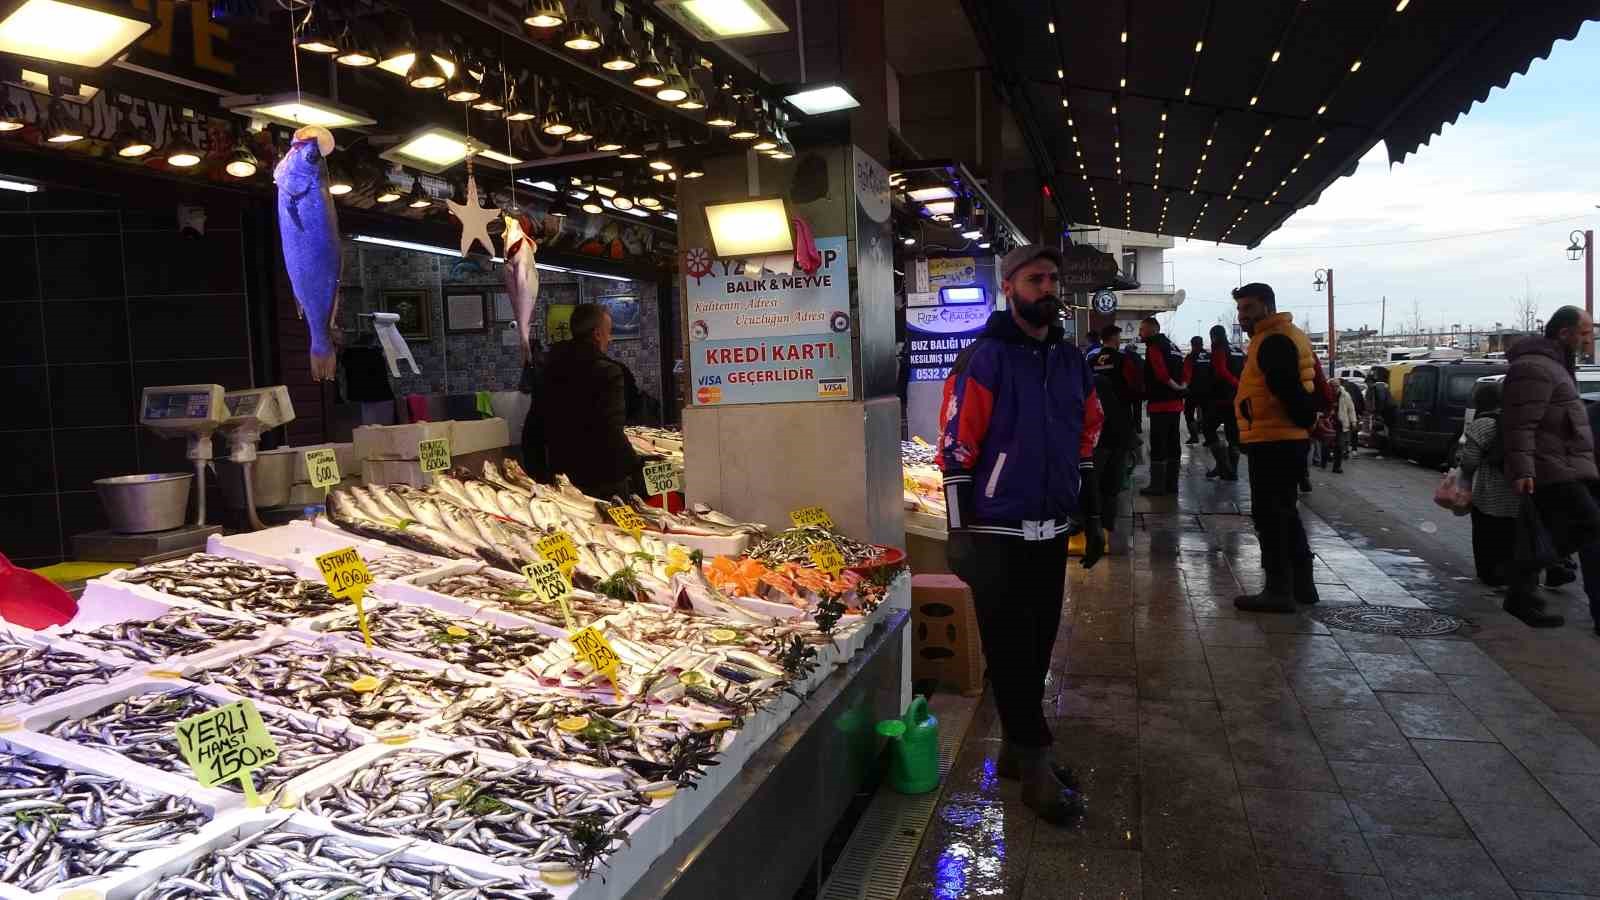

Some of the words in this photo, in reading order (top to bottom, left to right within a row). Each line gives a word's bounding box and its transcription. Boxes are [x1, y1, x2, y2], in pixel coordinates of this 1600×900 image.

[726, 280, 766, 293] BALIK
[770, 279, 780, 290] &
[782, 275, 832, 289] MEYVE
[695, 302, 738, 312] Kalitenin
[745, 297, 778, 311] Adresi
[735, 312, 790, 327] Ucuzluğun
[793, 311, 825, 322] Adresi
[911, 340, 929, 350] BUZ
[930, 337, 958, 350] BALIĞI
[960, 338, 976, 349] VA
[706, 342, 766, 365] KREDİ
[772, 342, 834, 361] KARTI
[698, 375, 722, 386] VISA
[728, 367, 814, 385] GEÇERLİDİR
[823, 383, 843, 392] VISA
[916, 367, 940, 380] 0532
[178, 703, 249, 752] YERLİ
